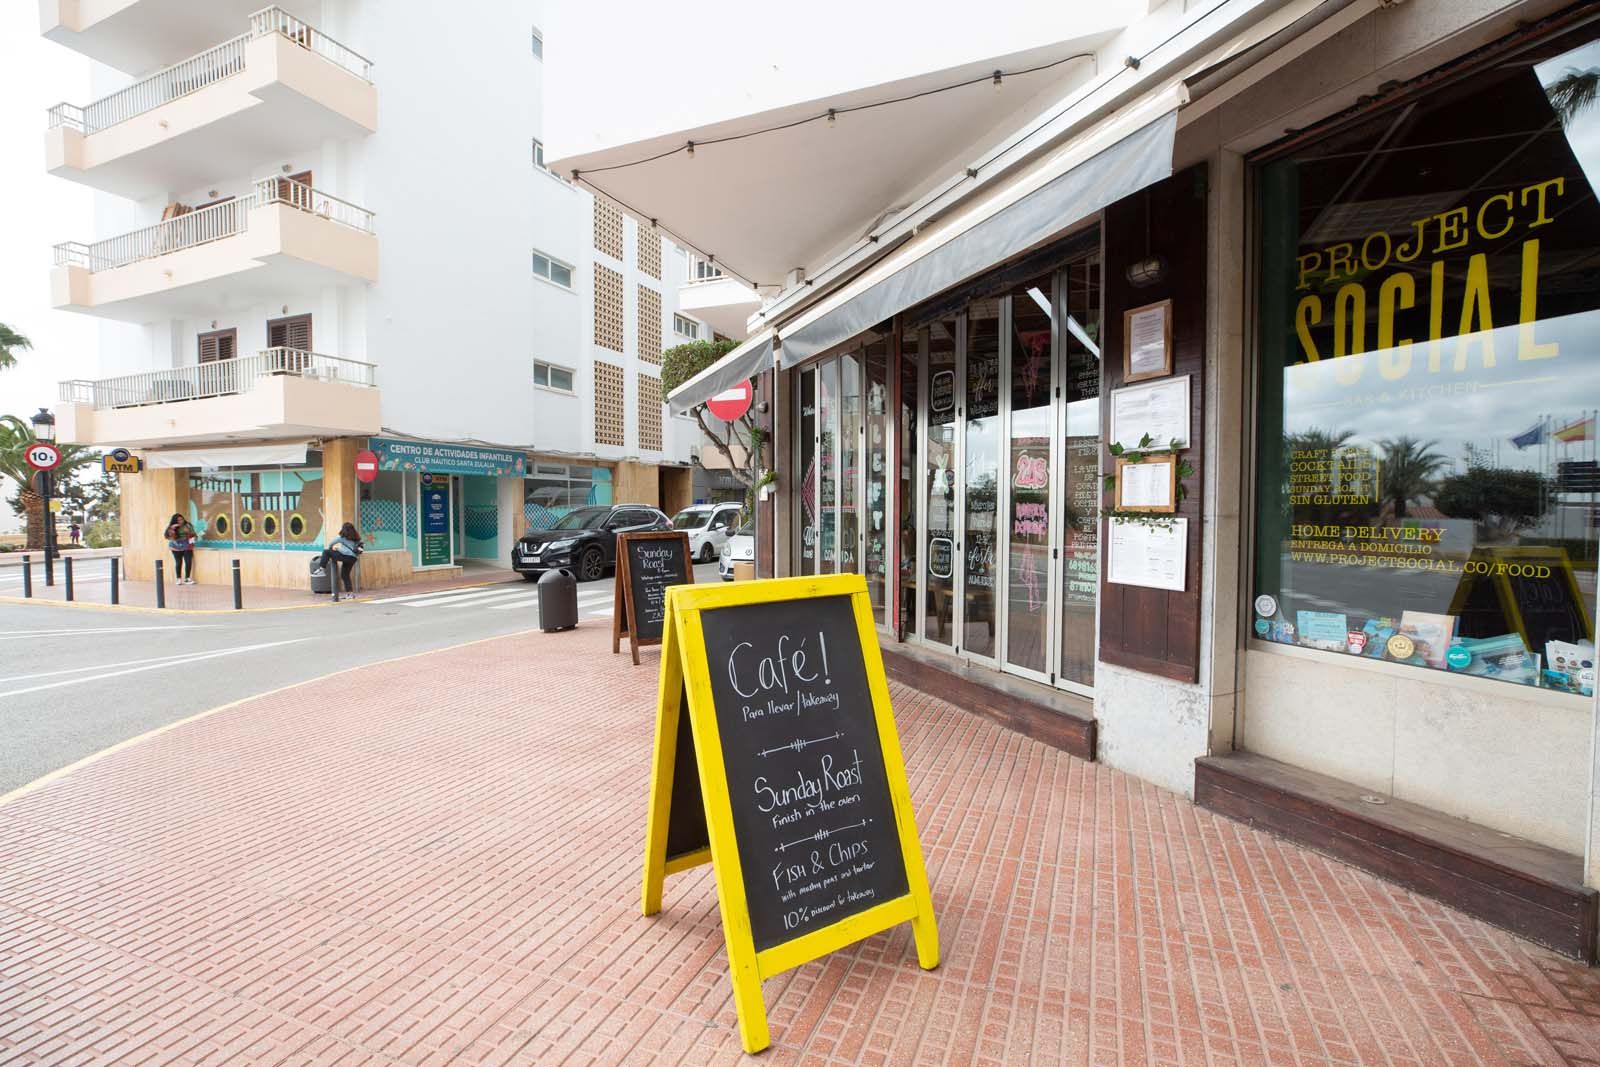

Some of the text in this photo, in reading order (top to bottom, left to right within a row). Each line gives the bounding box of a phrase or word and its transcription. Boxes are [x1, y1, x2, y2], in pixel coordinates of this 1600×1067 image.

[1295, 177, 1565, 290] PROJECT
[1293, 238, 1560, 390] SOCIAL
[32, 452, 47, 461] 10
[390, 444, 513, 462] CENTRO DE ACTIVIDADES INFANTILES
[1290, 449, 1329, 460] CRAFT
[110, 464, 133, 472] ATM
[415, 456, 430, 464] CLUB
[431, 457, 455, 466] NÁUTICO
[456, 459, 474, 467] SANTA
[1290, 460, 1372, 472] COCKTAILS
[1290, 473, 1372, 483] STREET FOOD
[1290, 485, 1332, 494] SUNDAY
[1289, 495, 1369, 505] SIN GLUTEN
[1291, 525, 1447, 541] HOME DELIVERY
[637, 547, 673, 561] Sunday
[1291, 540, 1432, 554] ENTREGA A DOMICILIO
[642, 558, 665, 569] Roast
[1291, 551, 1551, 579] WWW.PROJECTSOCIAL.CO/FOOD
[728, 631, 832, 698] Café!
[742, 705, 764, 723] Para
[754, 749, 864, 813] Sunday Roast
[772, 793, 861, 829] Finish in the oven
[810, 850, 825, 875] &
[781, 889, 797, 904] with
[823, 874, 838, 889] peas
[783, 906, 810, 931] 10%
[847, 888, 876, 903] takeaway
